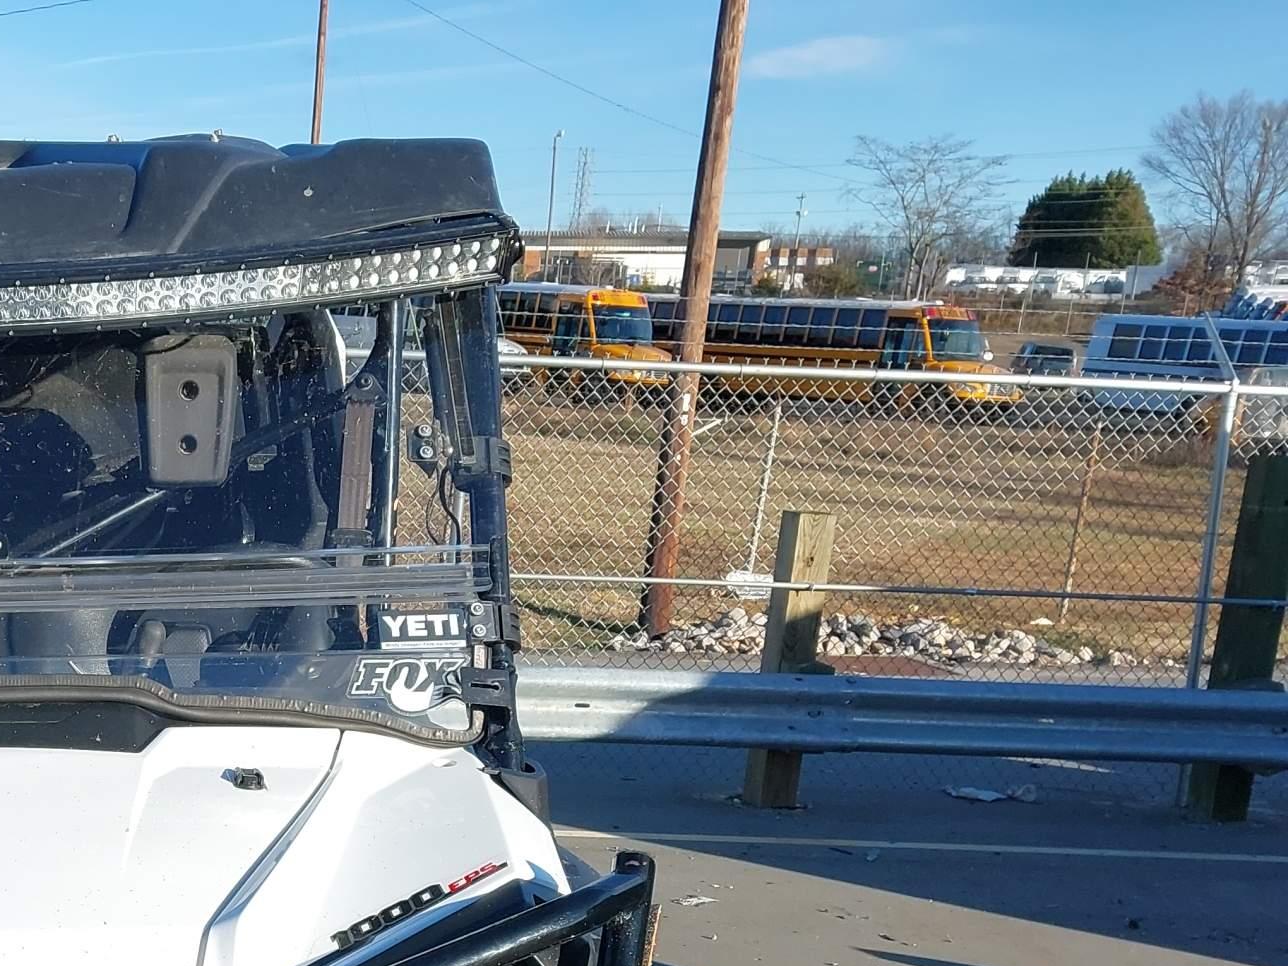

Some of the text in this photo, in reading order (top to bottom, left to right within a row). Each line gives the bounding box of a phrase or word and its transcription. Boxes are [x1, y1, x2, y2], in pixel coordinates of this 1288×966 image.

[383, 614, 460, 637] YETI
[350, 656, 466, 713] FOX
[330, 862, 498, 951] 1000 EPS
